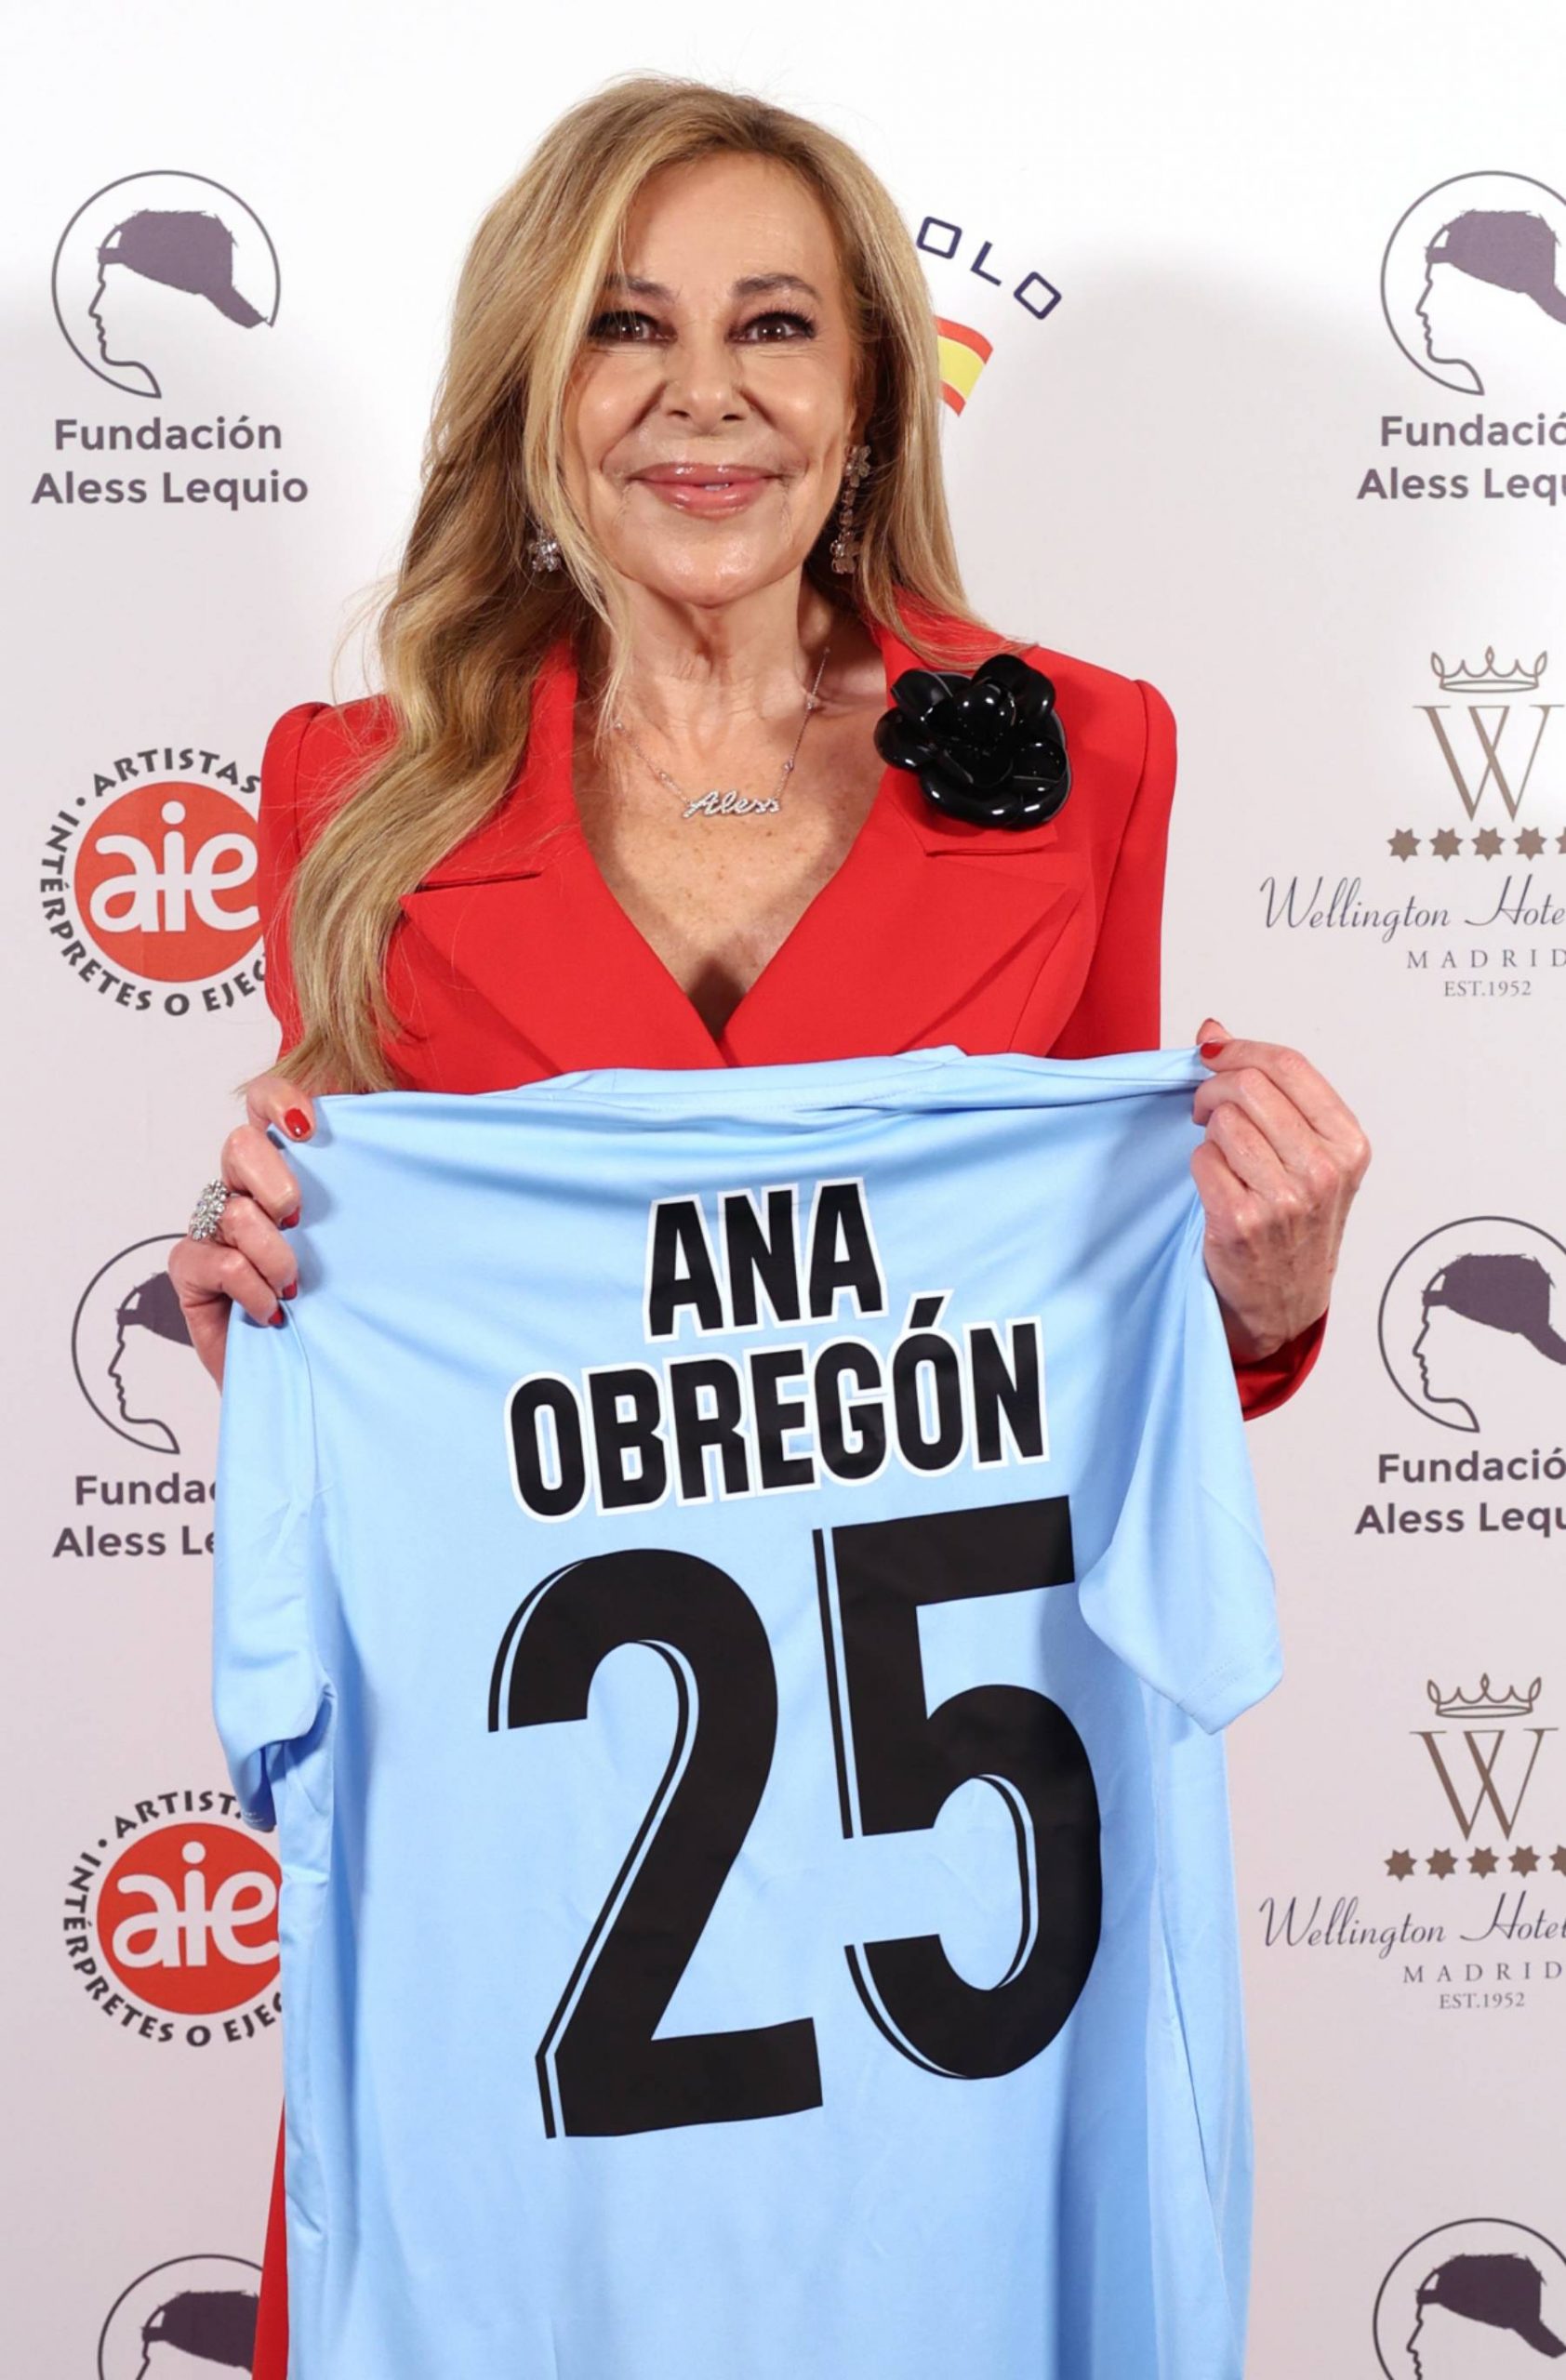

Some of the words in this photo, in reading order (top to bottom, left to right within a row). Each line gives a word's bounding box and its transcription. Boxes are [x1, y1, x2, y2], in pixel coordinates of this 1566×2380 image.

[55, 415, 282, 450] Fundación
[31, 470, 147, 504] Aless
[163, 469, 309, 511] Lequio
[1356, 467, 1469, 500] Aless
[1484, 468, 1566, 507] Leq
[93, 747, 261, 798] ARTISTAS
[683, 789, 779, 818] Aless
[89, 800, 260, 933] aie
[40, 810, 153, 1012] INTÉRPRETES
[164, 993, 191, 1016] O
[1259, 875, 1451, 944] Wellington
[1406, 948, 1566, 969] MADRID
[1443, 980, 1533, 998] EST.1952
[645, 1177, 888, 1344] ANA
[504, 1289, 1051, 1524] OBREGÓN
[1378, 1447, 1566, 1484] Fundació
[75, 1473, 216, 1506] Funda
[1354, 1502, 1465, 1535] Aless
[52, 1525, 166, 1558] Aless
[114, 1790, 241, 1839] ARTIST
[488, 1494, 1103, 2139] 25
[112, 1840, 280, 1969] aie
[63, 1851, 175, 2043] INTÉRPRETES
[185, 2024, 212, 2047] O
[1259, 1896, 1447, 1960] Wellington
[1402, 1961, 1562, 1984] MADRID
[1439, 1991, 1526, 2010] EST.1952
